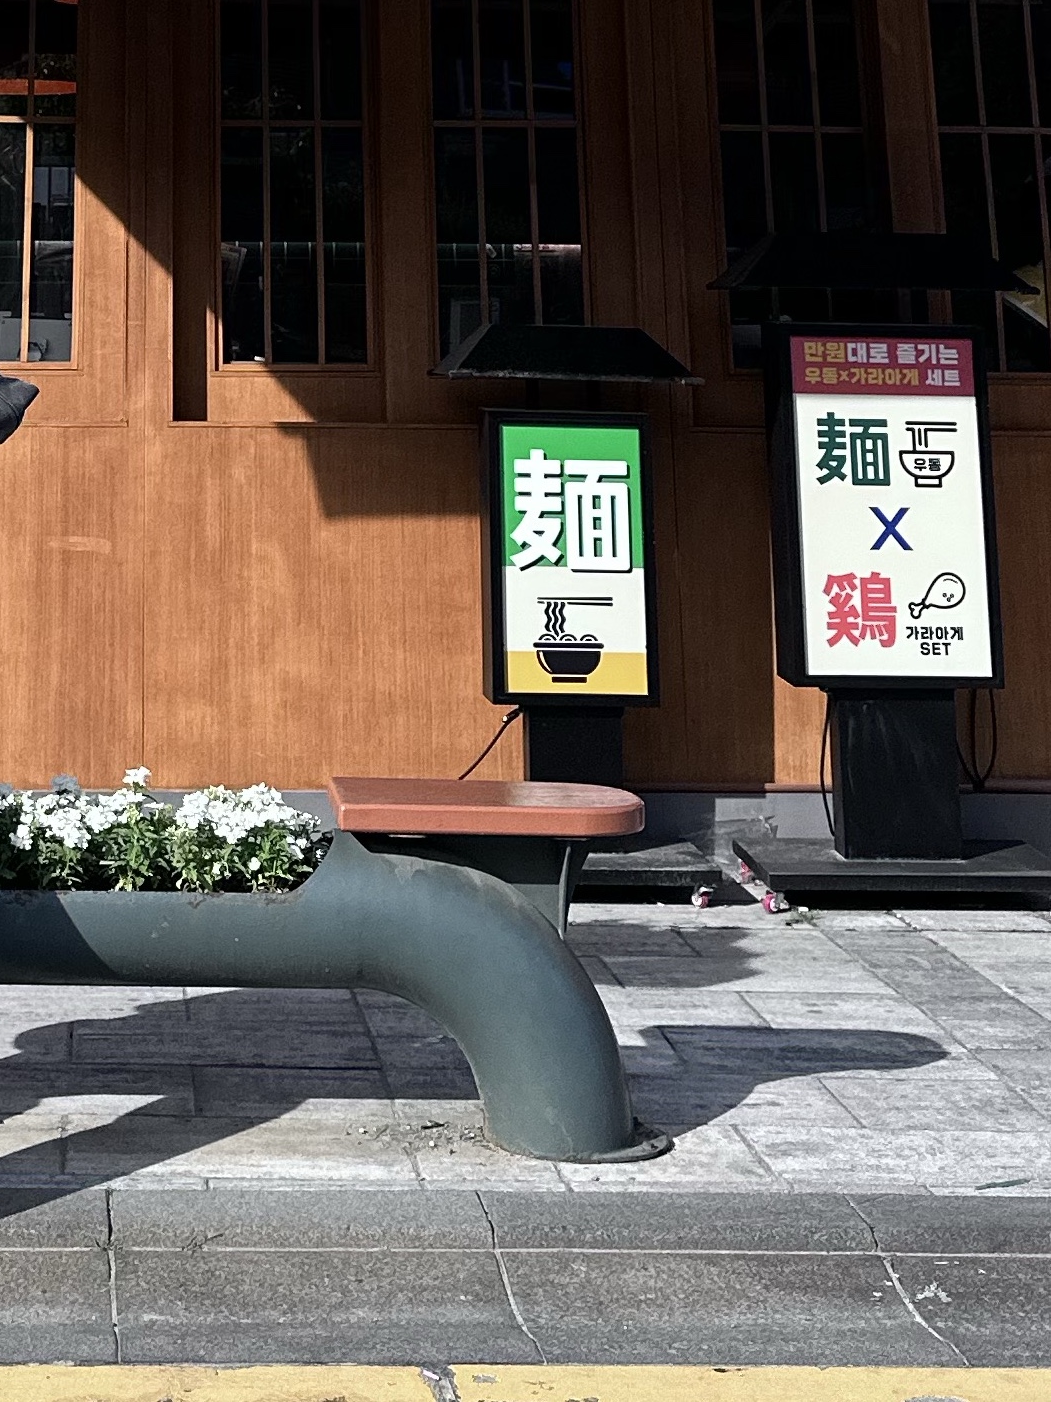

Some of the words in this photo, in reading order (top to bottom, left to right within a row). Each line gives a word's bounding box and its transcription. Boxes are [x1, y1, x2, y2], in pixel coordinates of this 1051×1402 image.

[803, 341, 890, 364] 만원대로
[896, 343, 959, 365] 즐기는
[925, 368, 961, 387] 세트
[913, 457, 942, 472] 우동
[905, 625, 964, 641] 가라아게
[920, 642, 952, 656] SET
